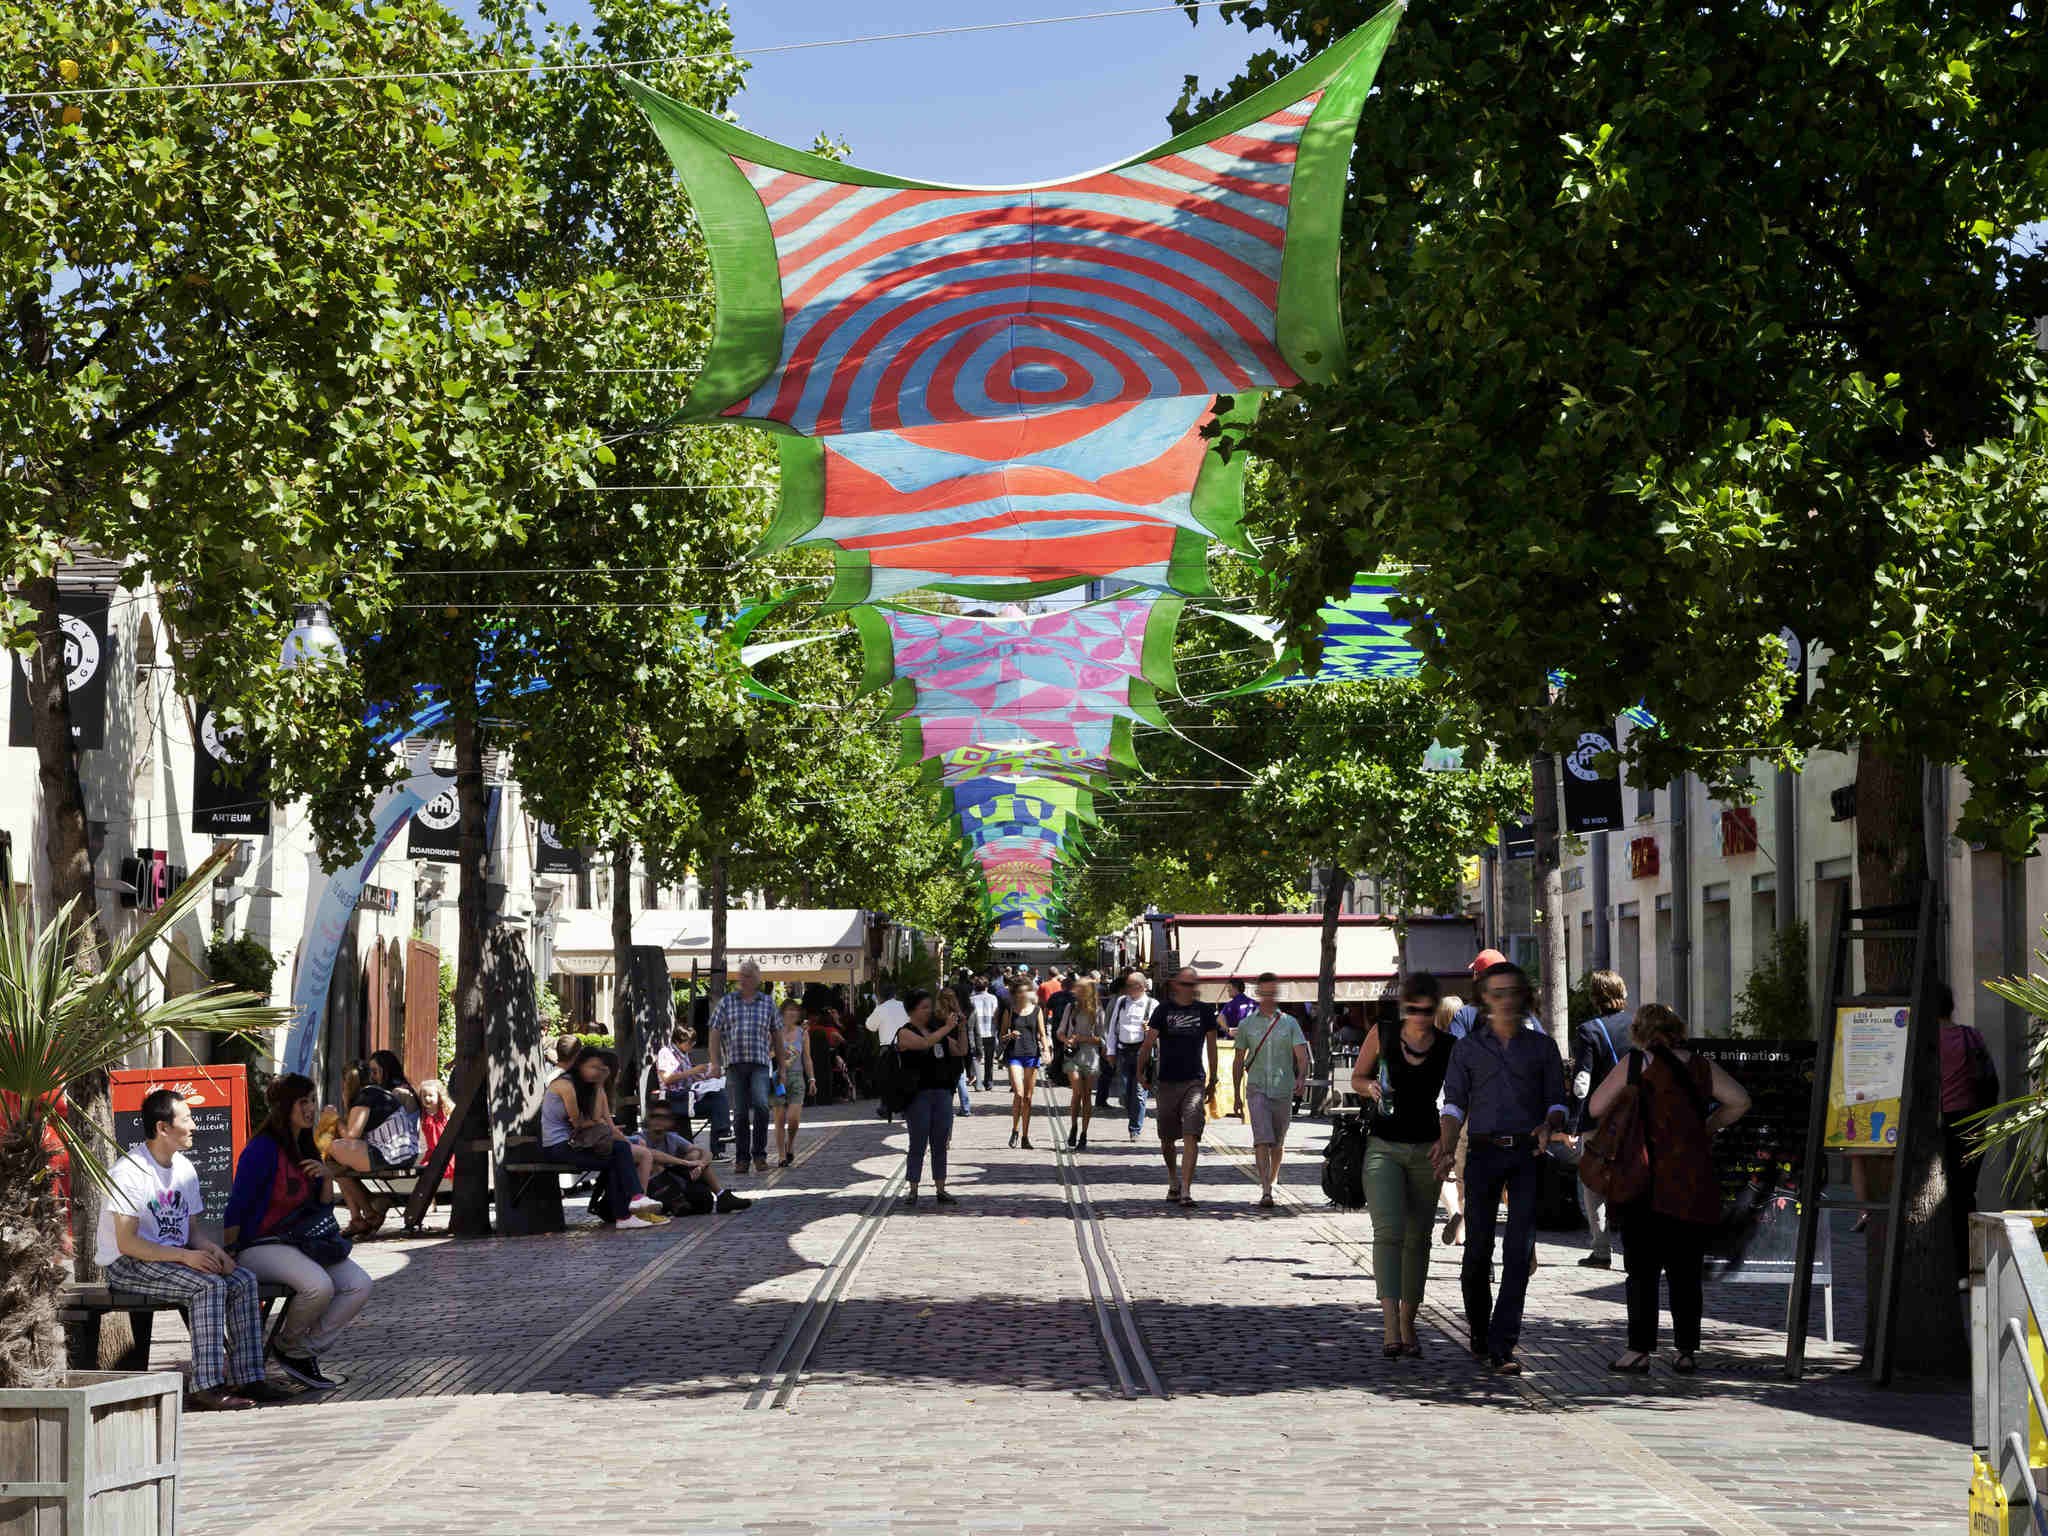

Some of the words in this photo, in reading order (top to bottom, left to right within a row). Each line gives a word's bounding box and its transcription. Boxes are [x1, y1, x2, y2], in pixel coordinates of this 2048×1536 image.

[211, 813, 252, 823] ARTEUM
[409, 846, 460, 857] BOARDRIDERS
[1720, 1049, 1790, 1061] animations
